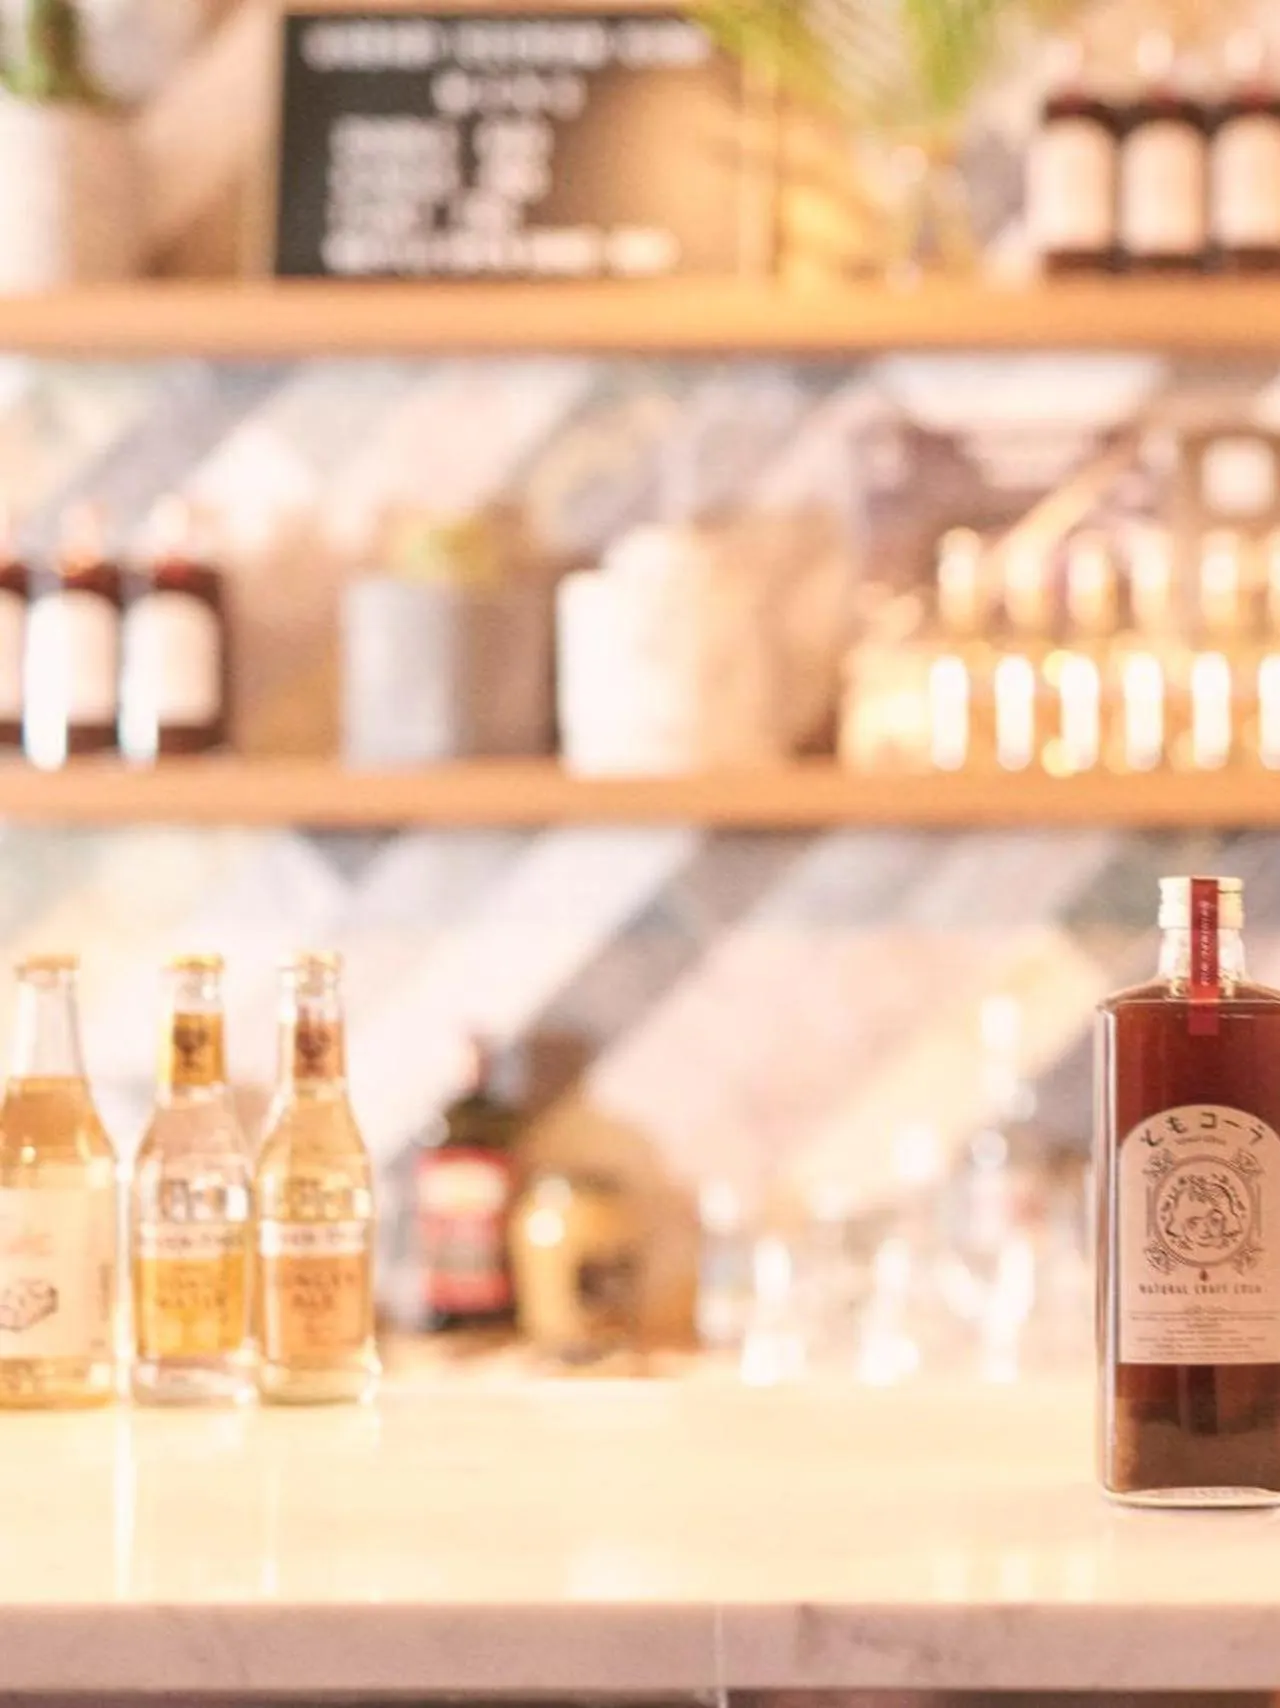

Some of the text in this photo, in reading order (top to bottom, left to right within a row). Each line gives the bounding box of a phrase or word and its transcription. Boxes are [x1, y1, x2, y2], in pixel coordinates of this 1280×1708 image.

[1139, 1112, 1266, 1147] ともコーラ
[1138, 1283, 1190, 1296] NATURAL
[1193, 1283, 1228, 1296] CRAFT
